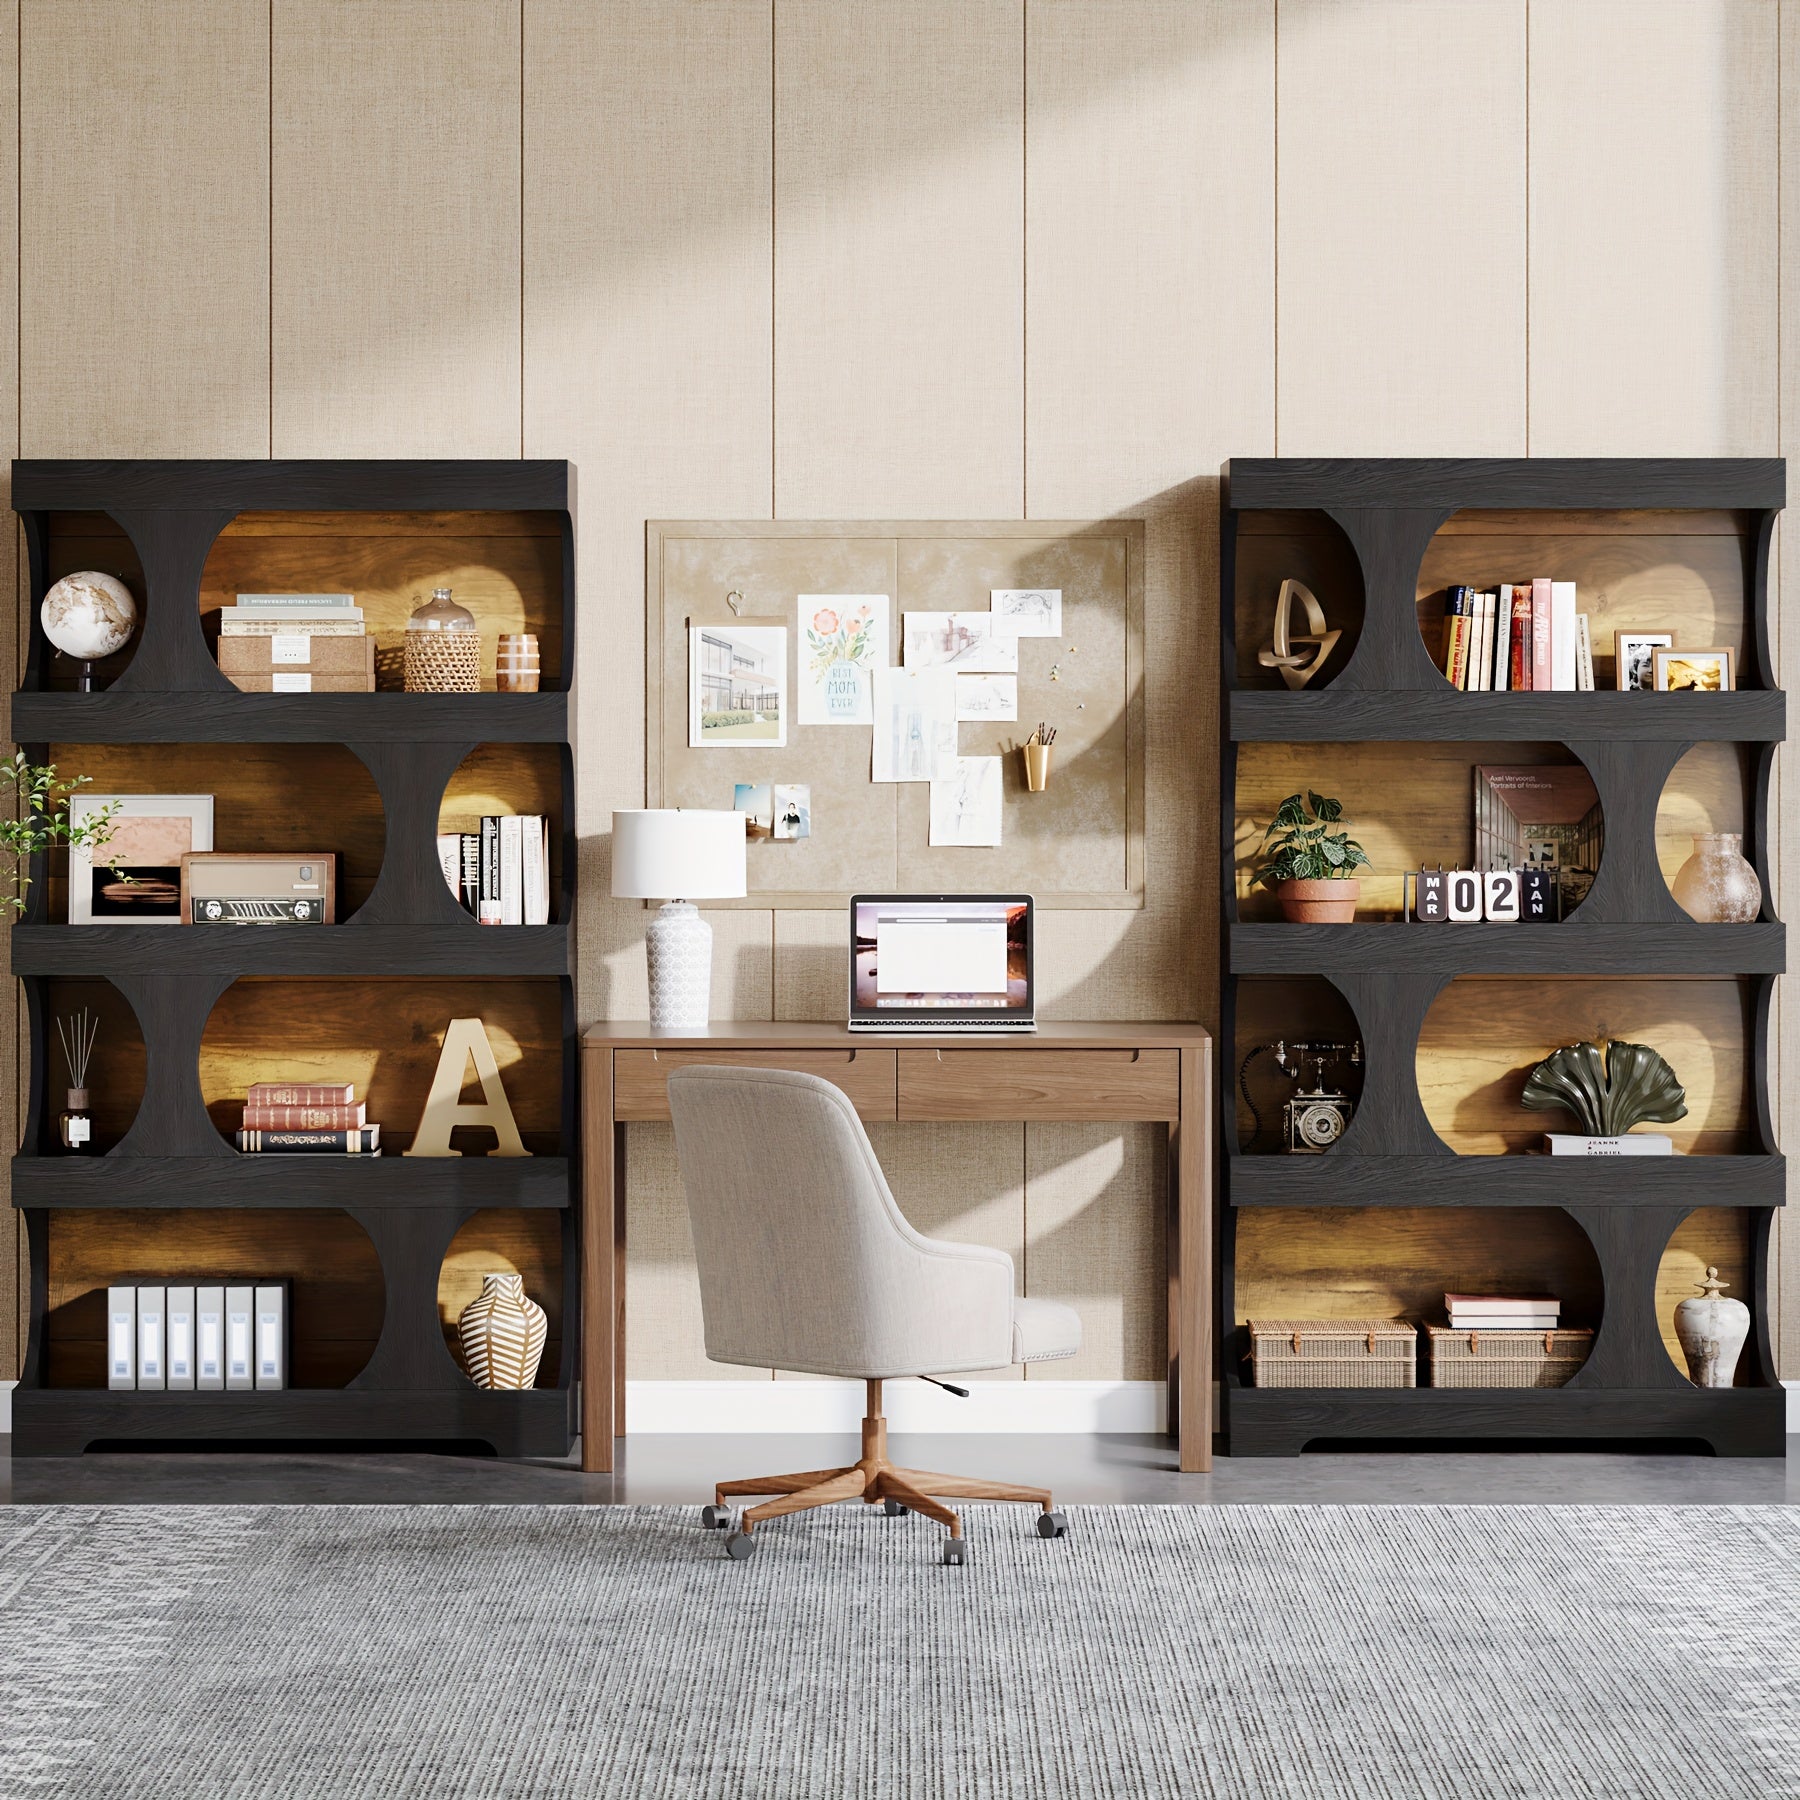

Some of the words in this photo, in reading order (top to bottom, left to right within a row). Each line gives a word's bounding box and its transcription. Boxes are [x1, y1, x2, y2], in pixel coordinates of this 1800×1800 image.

[832, 668, 852, 678] BEST
[828, 681, 856, 694] MOM
[831, 698, 853, 708] EVER
[1426, 877, 1440, 914] MAR
[1530, 877, 1543, 914] JAN
[402, 1018, 534, 1157] A
